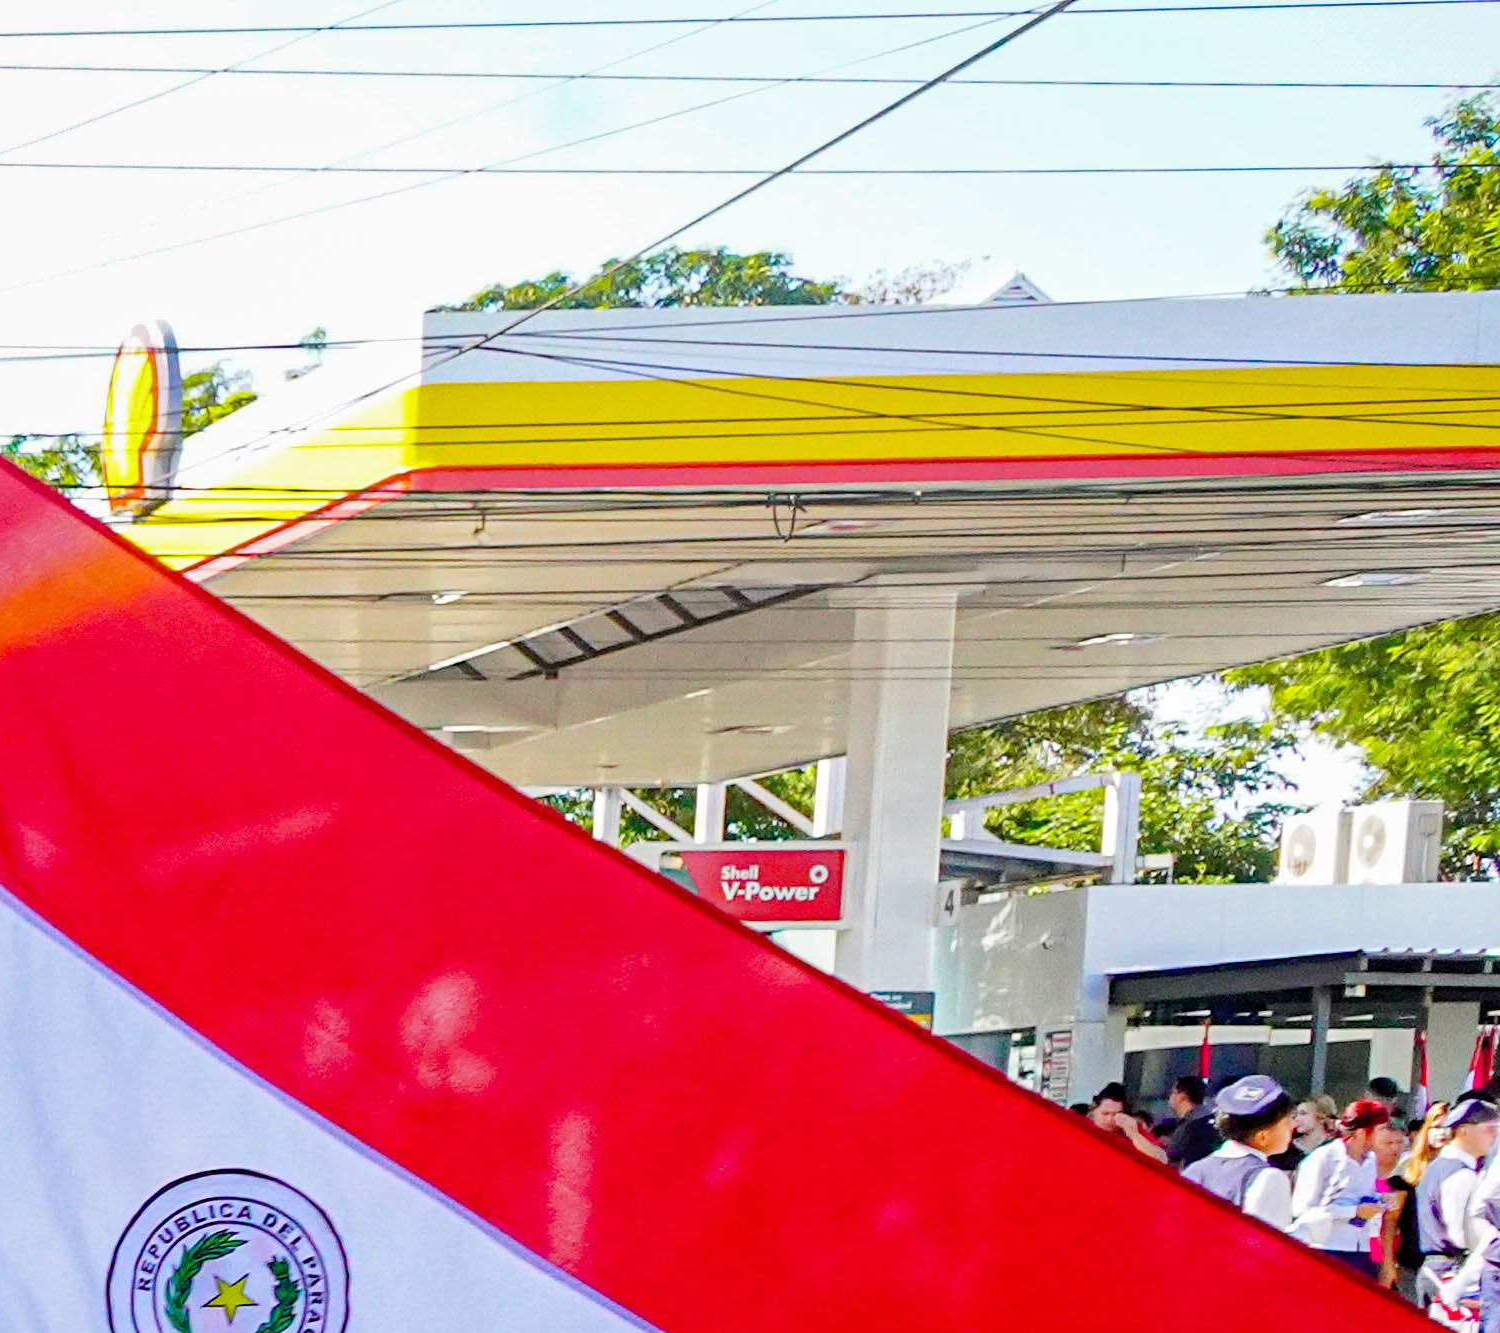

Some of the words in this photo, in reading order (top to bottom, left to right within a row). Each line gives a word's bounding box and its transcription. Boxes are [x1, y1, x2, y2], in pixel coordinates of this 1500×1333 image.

[721, 865, 758, 880] Shell
[721, 882, 819, 901] V-Power
[943, 890, 954, 916] 4
[137, 1204, 251, 1291] REPUBLICA
[263, 1213, 303, 1254] DEL
